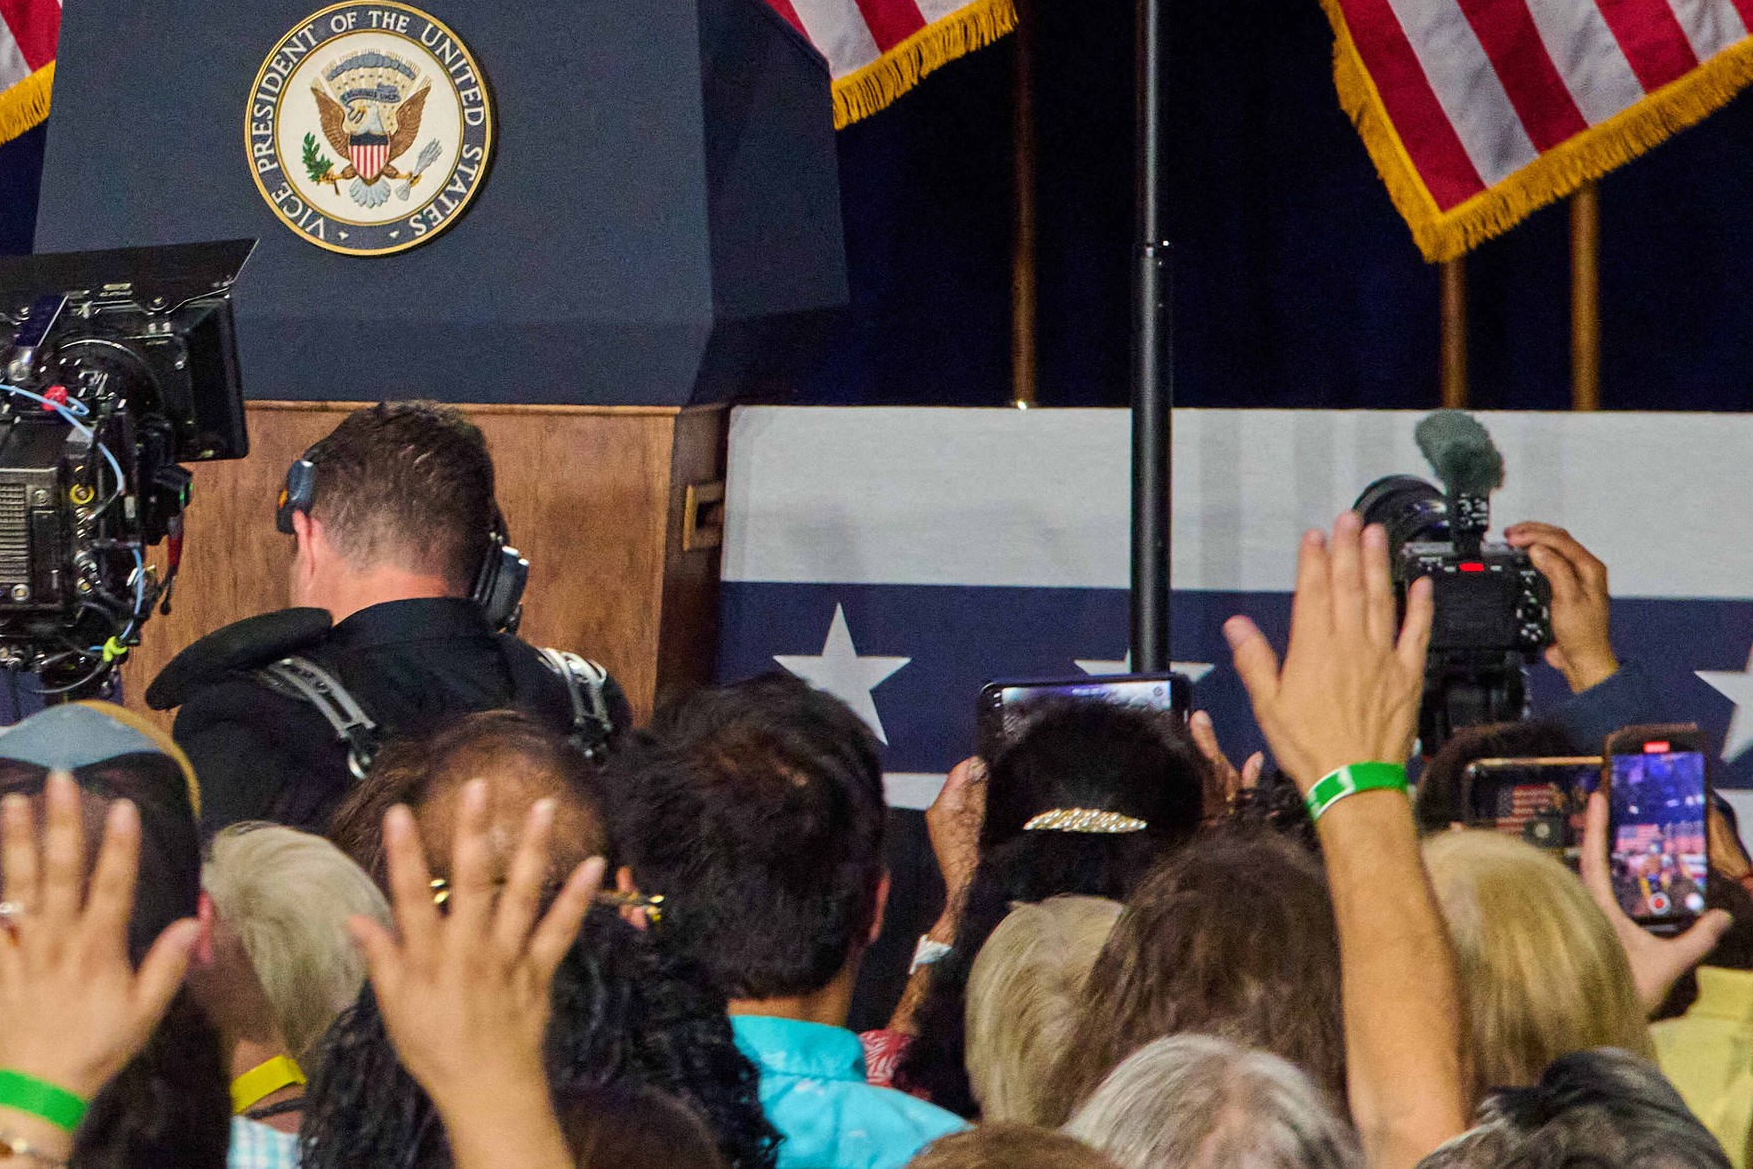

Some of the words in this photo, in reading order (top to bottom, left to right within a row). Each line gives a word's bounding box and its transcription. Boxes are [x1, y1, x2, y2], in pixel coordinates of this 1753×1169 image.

[330, 11, 358, 34] OF
[368, 10, 410, 34] THE
[251, 24, 317, 173] PRESIDENT
[420, 24, 486, 127] UNITED
[270, 182, 326, 240] VICE
[409, 145, 482, 236] STATES
